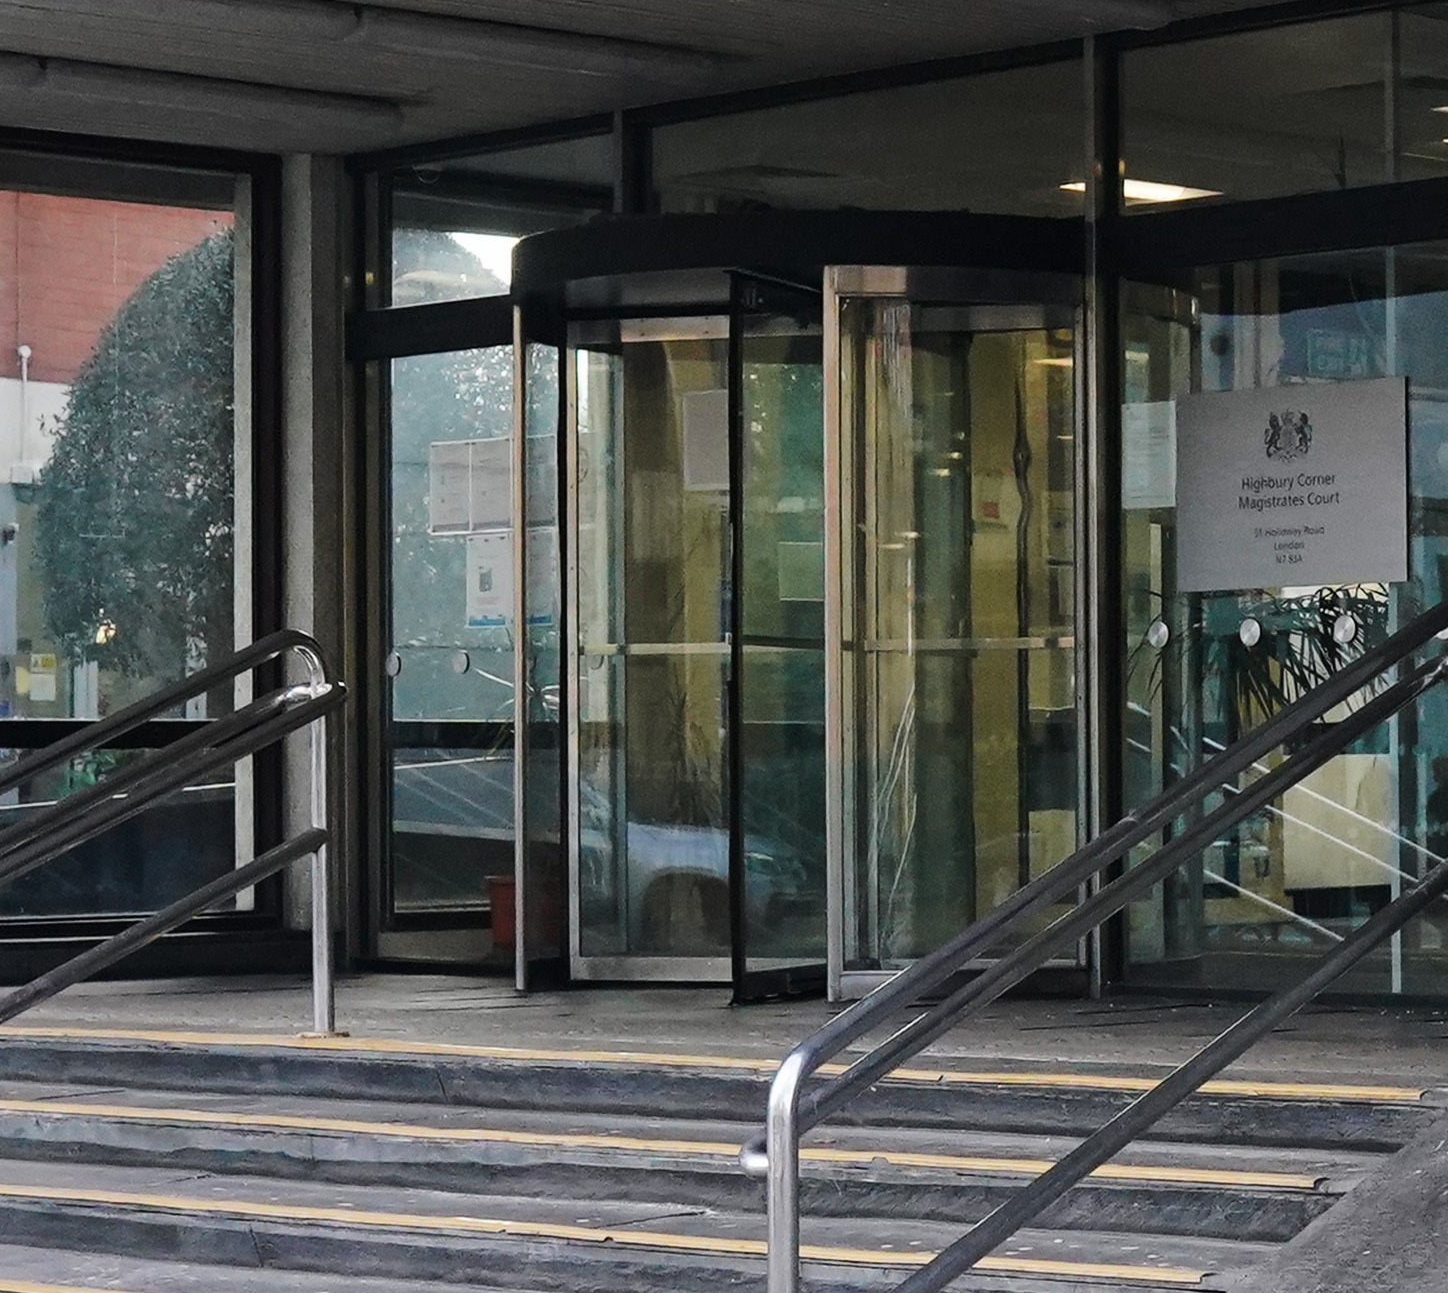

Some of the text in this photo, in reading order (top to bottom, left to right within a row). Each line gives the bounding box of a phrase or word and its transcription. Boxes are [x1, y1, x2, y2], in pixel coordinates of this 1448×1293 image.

[1241, 472, 1335, 494] Highbury Corner
[1238, 492, 1340, 512] Magistrates Court
[1303, 525, 1325, 535] Road
[1273, 540, 1305, 551] London
